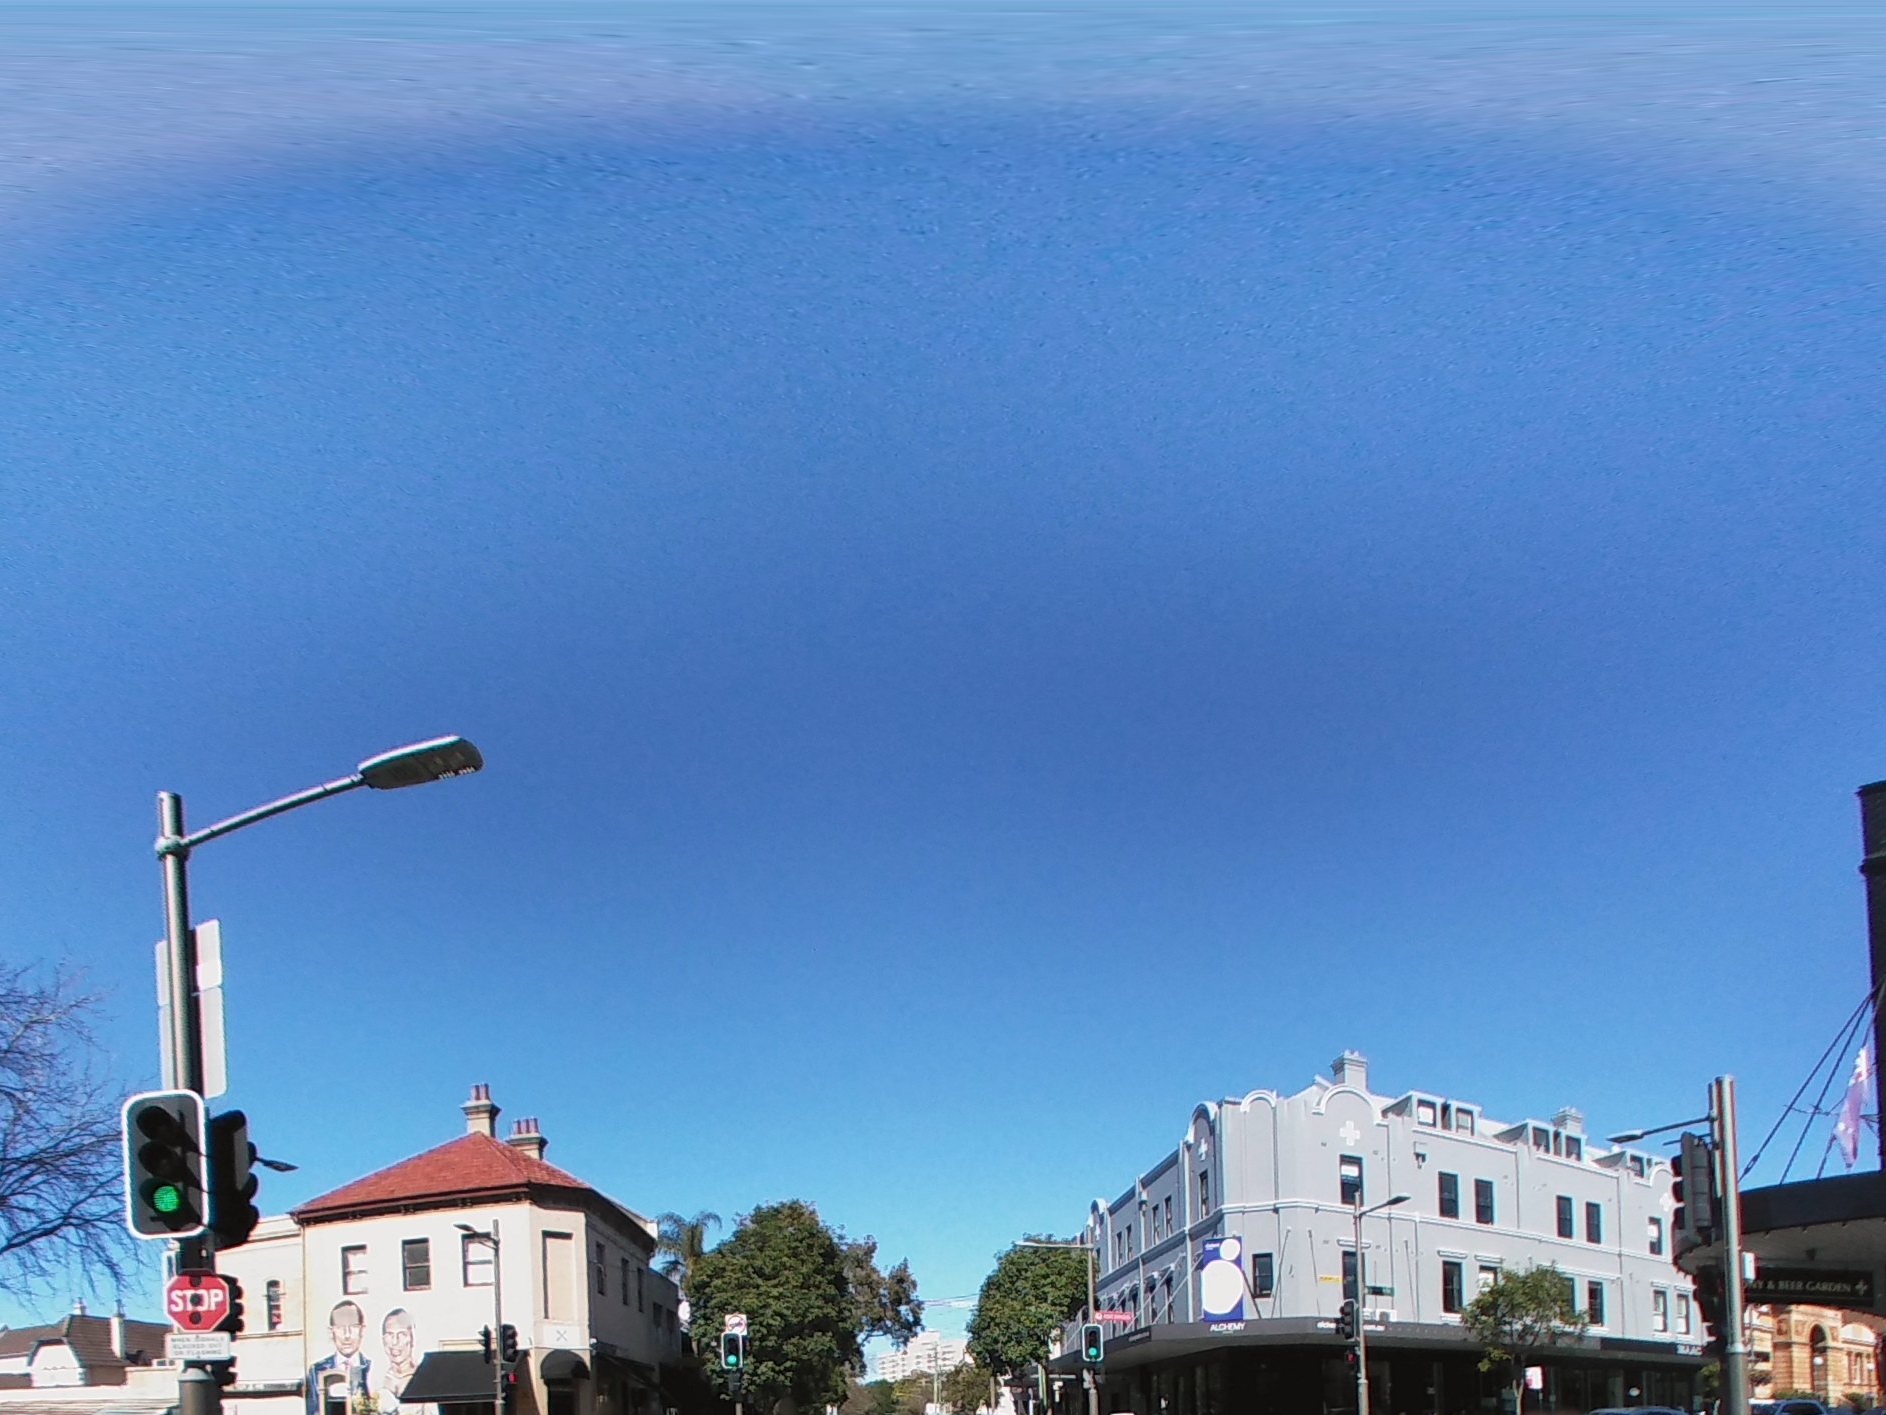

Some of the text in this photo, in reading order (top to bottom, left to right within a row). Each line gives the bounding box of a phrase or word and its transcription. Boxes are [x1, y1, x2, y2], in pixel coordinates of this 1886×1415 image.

[1778, 1280, 1803, 1290] BEER
[1805, 1280, 1851, 1292] GARDEN
[170, 1289, 224, 1312] STOP
[1209, 1321, 1246, 1332] ALCHEMY
